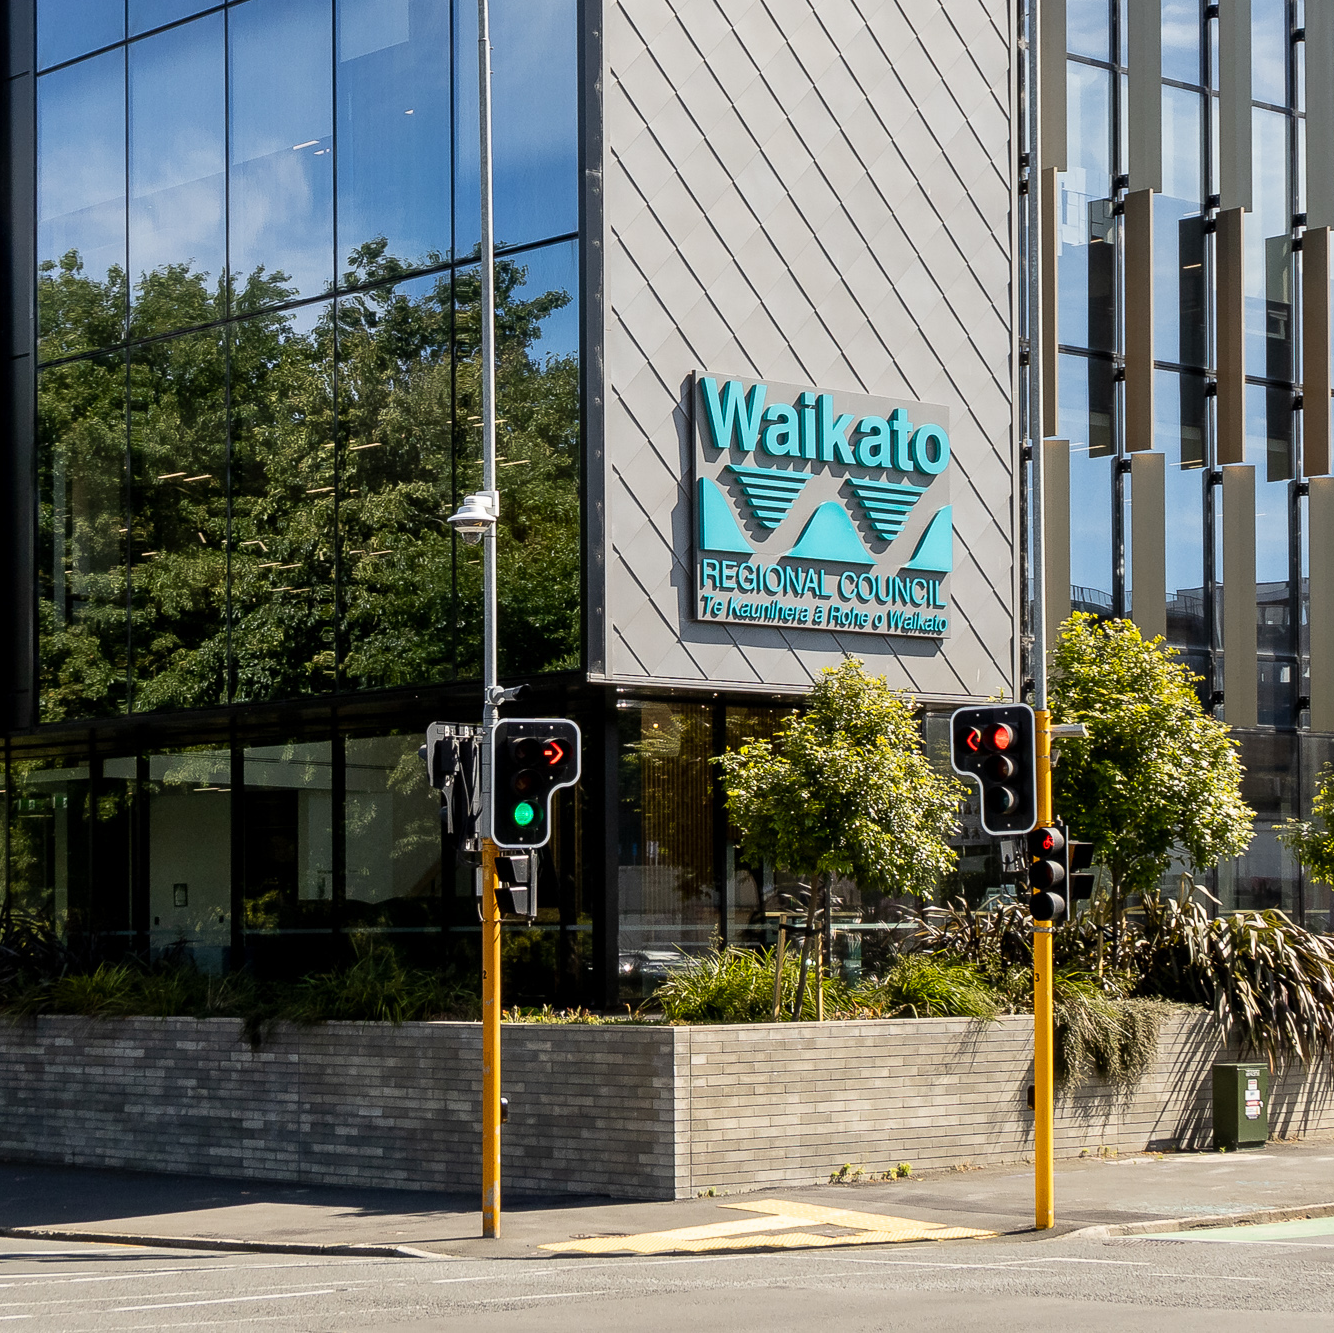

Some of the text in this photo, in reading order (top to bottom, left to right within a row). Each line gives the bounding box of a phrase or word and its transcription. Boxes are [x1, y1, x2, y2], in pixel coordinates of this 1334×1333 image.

[701, 376, 950, 475] Waikato
[702, 558, 948, 607] REGIONAL COUNCIL
[703, 594, 948, 633] Te Kaunihera ā Rohe o Waikato
[1035, 972, 1040, 982] 3
